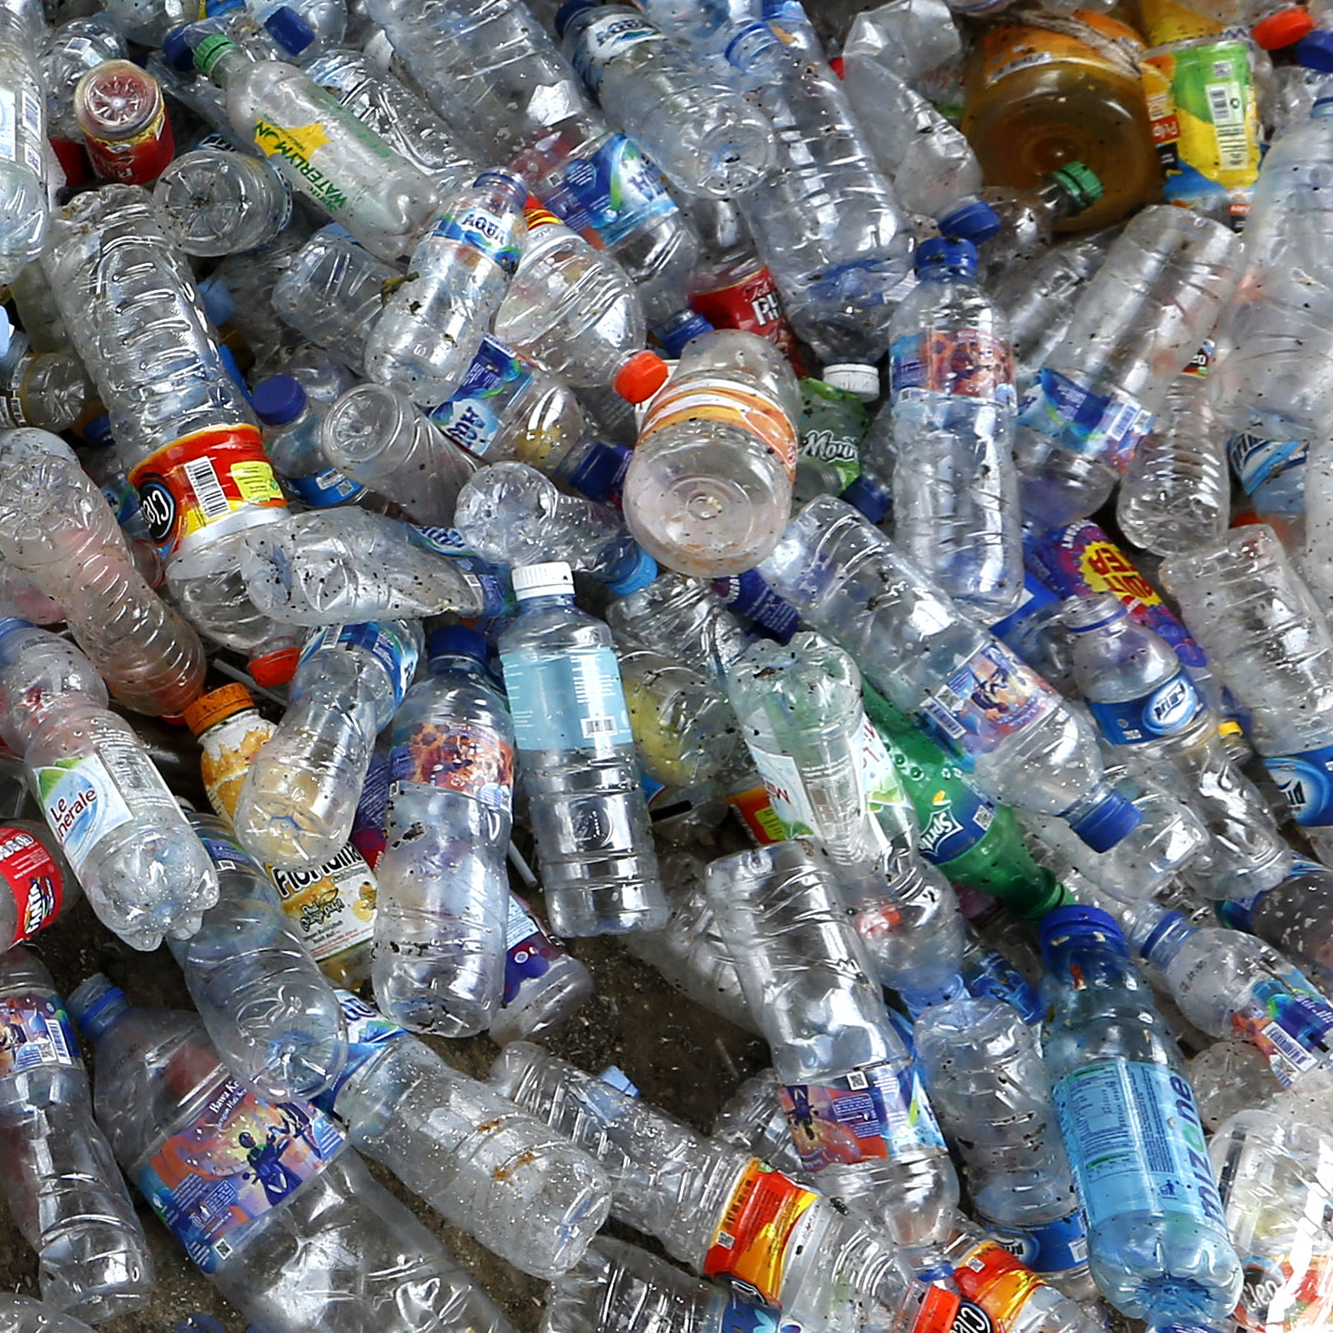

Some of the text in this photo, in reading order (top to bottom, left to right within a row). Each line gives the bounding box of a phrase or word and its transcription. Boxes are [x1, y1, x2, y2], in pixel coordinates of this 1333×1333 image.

[253, 121, 348, 209] WATERLYMON
[462, 211, 507, 246] AQUA
[50, 800, 68, 823] Le
[1169, 1075, 1226, 1228] mizone
